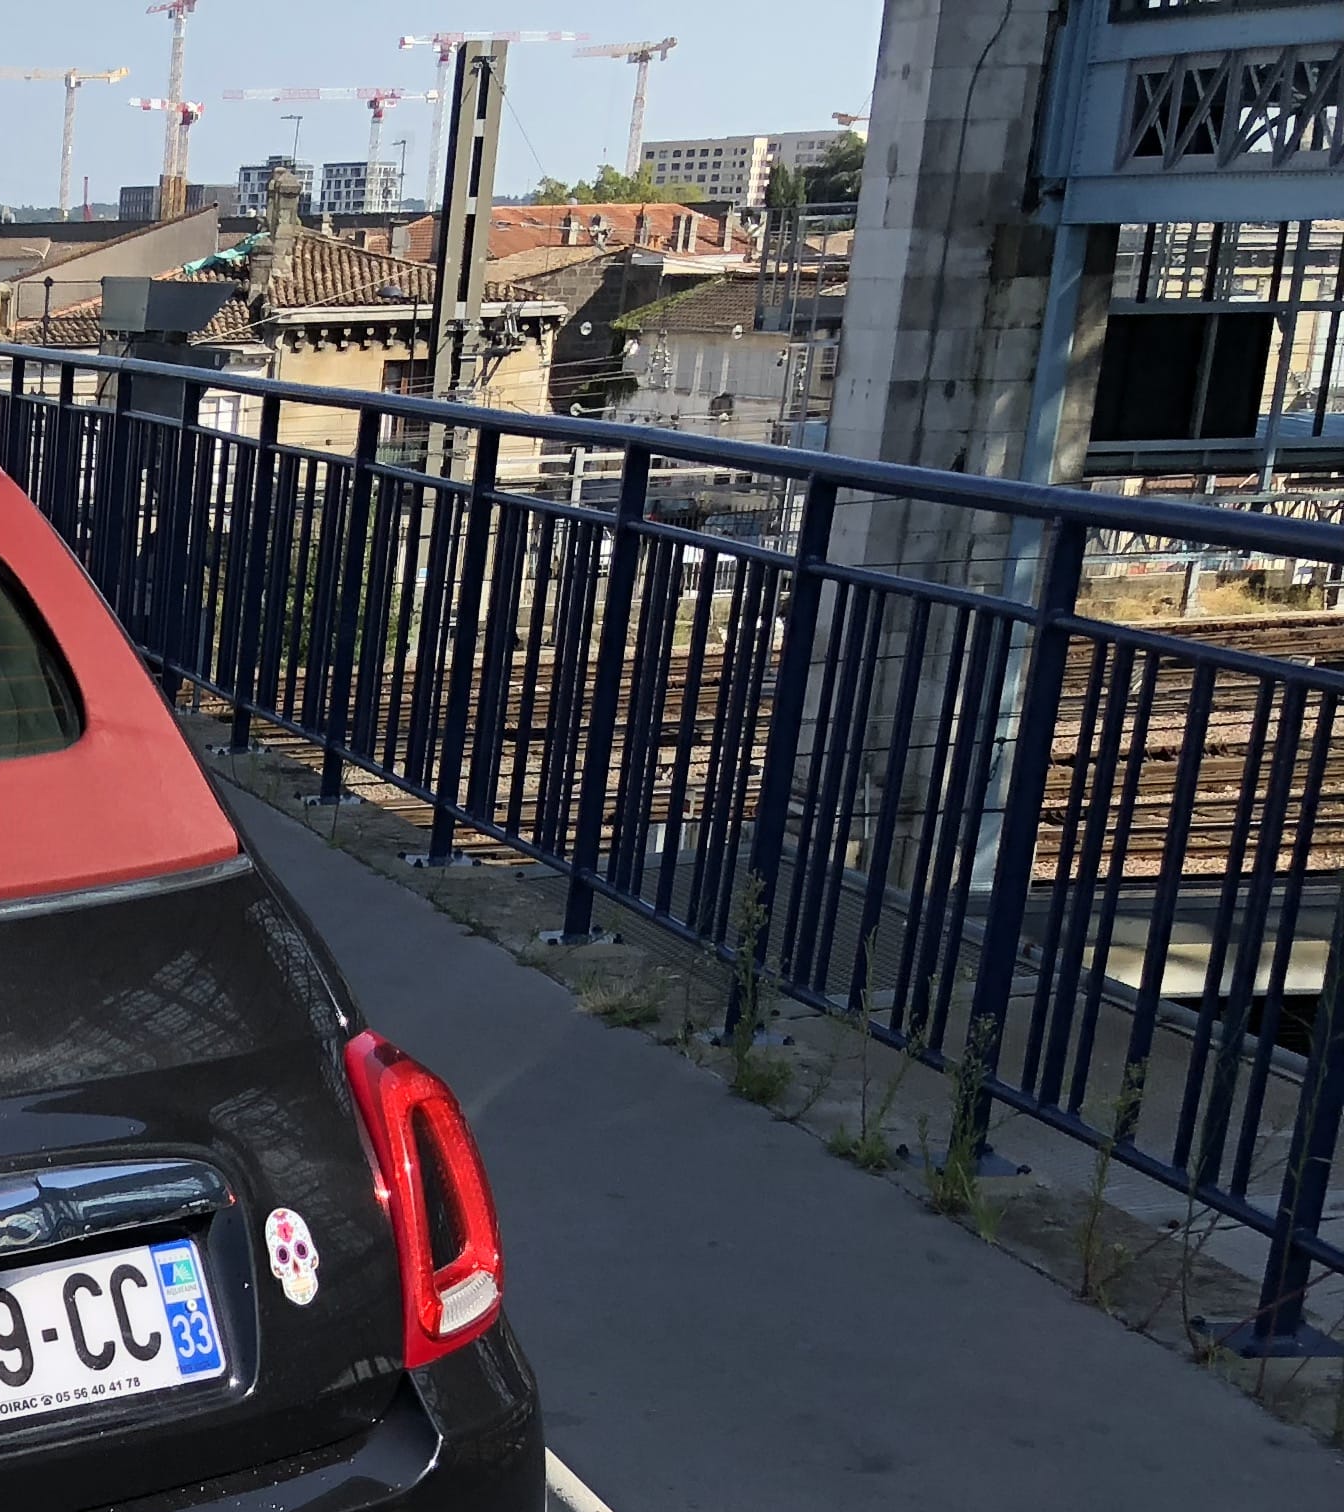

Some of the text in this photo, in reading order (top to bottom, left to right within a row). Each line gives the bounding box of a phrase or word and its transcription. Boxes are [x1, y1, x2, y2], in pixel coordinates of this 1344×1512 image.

[172, 1311, 213, 1359] 33
[55, 1391, 71, 1404] 05
[73, 1387, 88, 1400] 56
[91, 1383, 106, 1396] 40
[109, 1379, 123, 1392] 41
[126, 1376, 141, 1389] 78
